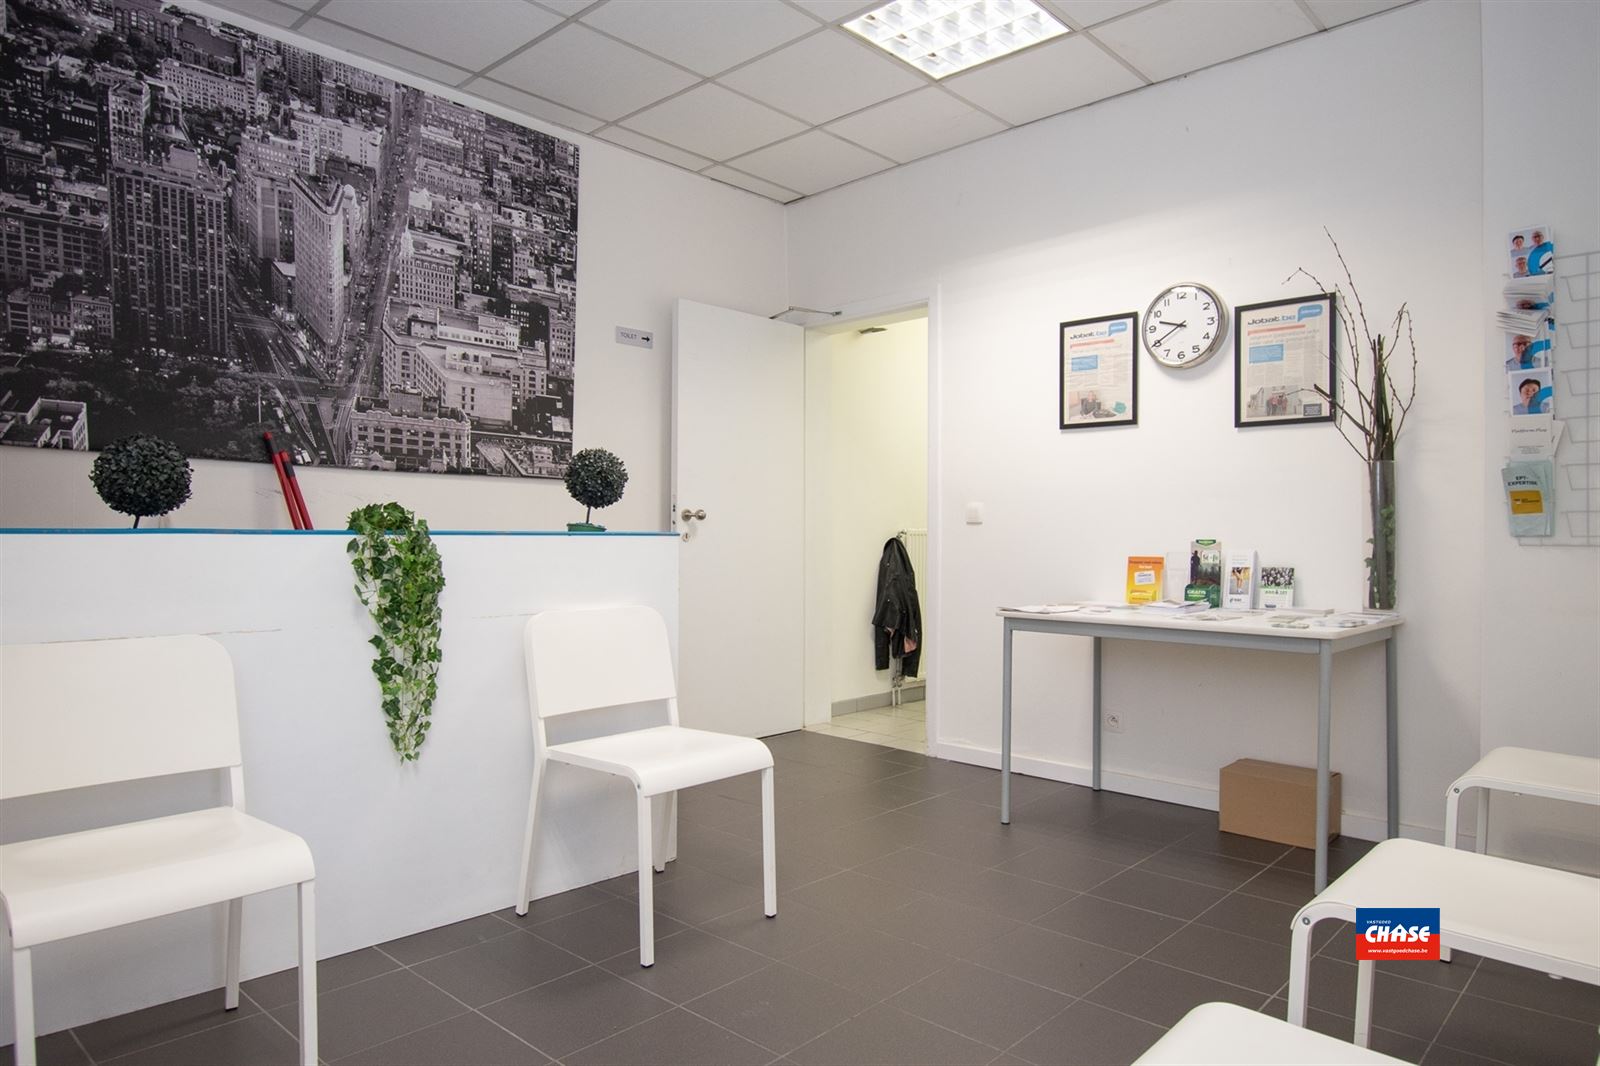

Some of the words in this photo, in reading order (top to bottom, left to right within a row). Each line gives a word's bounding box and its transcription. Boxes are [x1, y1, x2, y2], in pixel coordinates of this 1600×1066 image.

[1177, 292, 1187, 300] 12
[1194, 293, 1198, 301] 1
[1203, 303, 1211, 311] 2
[1154, 311, 1162, 319] 10
[1207, 317, 1215, 326] 3
[1149, 325, 1157, 334] 9
[620, 331, 637, 340] TOILET
[1202, 332, 1210, 340] 4
[1153, 340, 1162, 348] 8
[1164, 349, 1171, 357] 7
[1192, 345, 1200, 353] 5
[1177, 351, 1186, 360] 6
